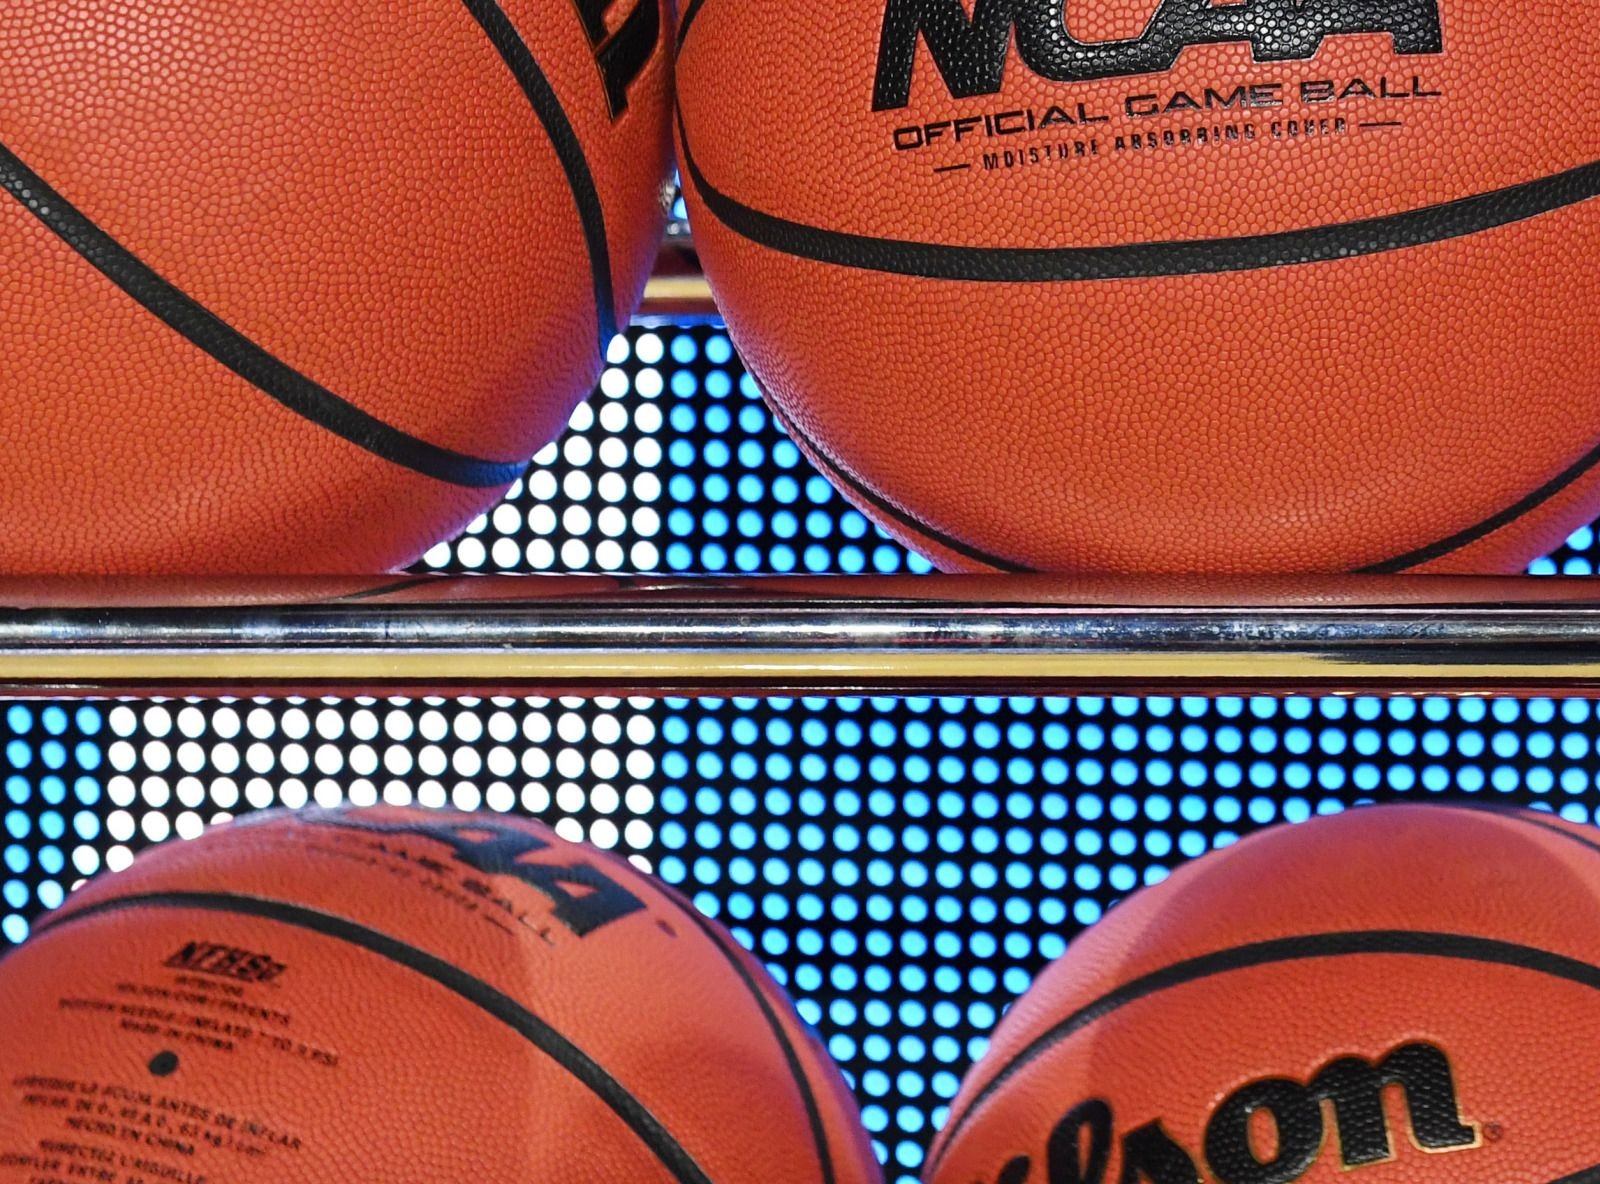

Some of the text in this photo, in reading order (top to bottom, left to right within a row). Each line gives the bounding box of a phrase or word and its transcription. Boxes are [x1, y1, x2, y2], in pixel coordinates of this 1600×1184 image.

[892, 75, 1443, 152] OFFICIAL GAME BALL
[982, 117, 1347, 171] MOISTURE ABSORBING COVER
